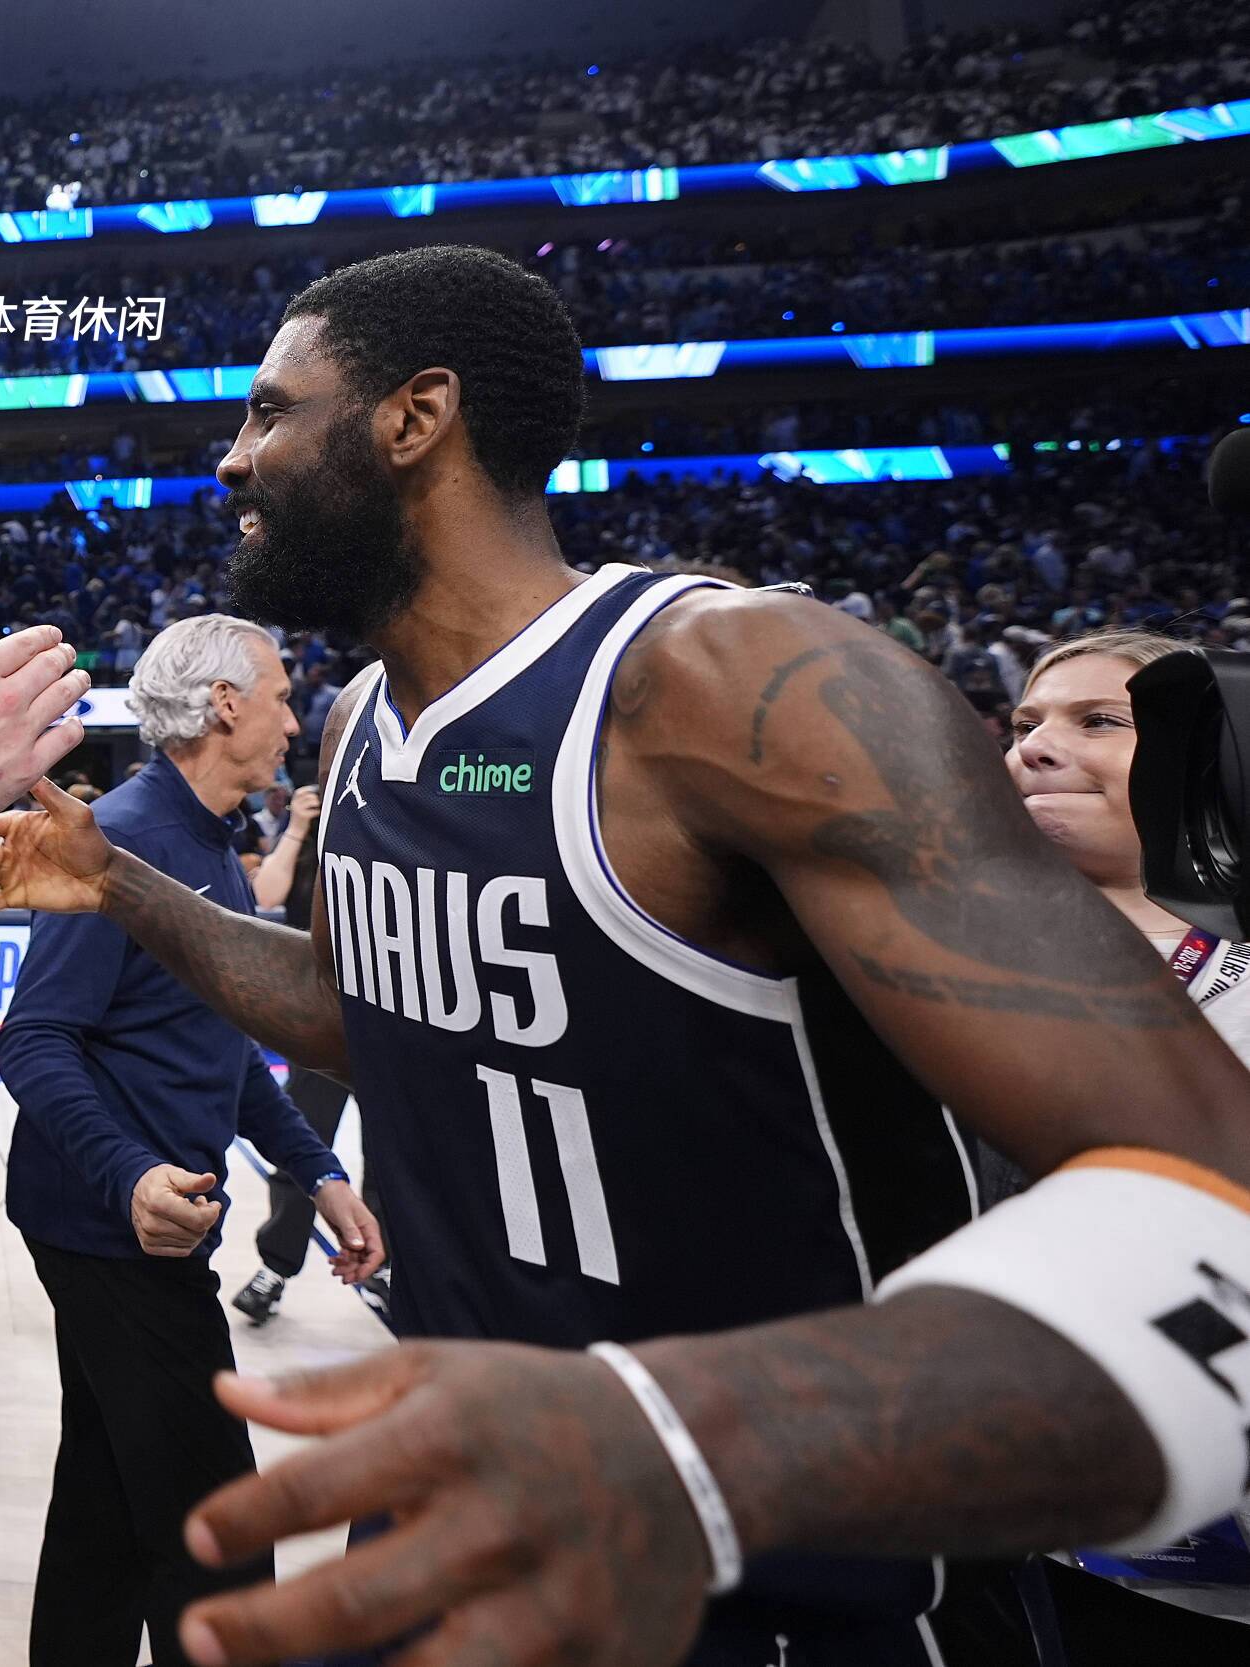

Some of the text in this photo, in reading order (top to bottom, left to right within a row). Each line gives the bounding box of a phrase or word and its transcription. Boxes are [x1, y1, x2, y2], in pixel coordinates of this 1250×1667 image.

[439, 754, 532, 793] chime
[324, 851, 569, 1048] MAVS
[476, 1063, 620, 1286] 11
